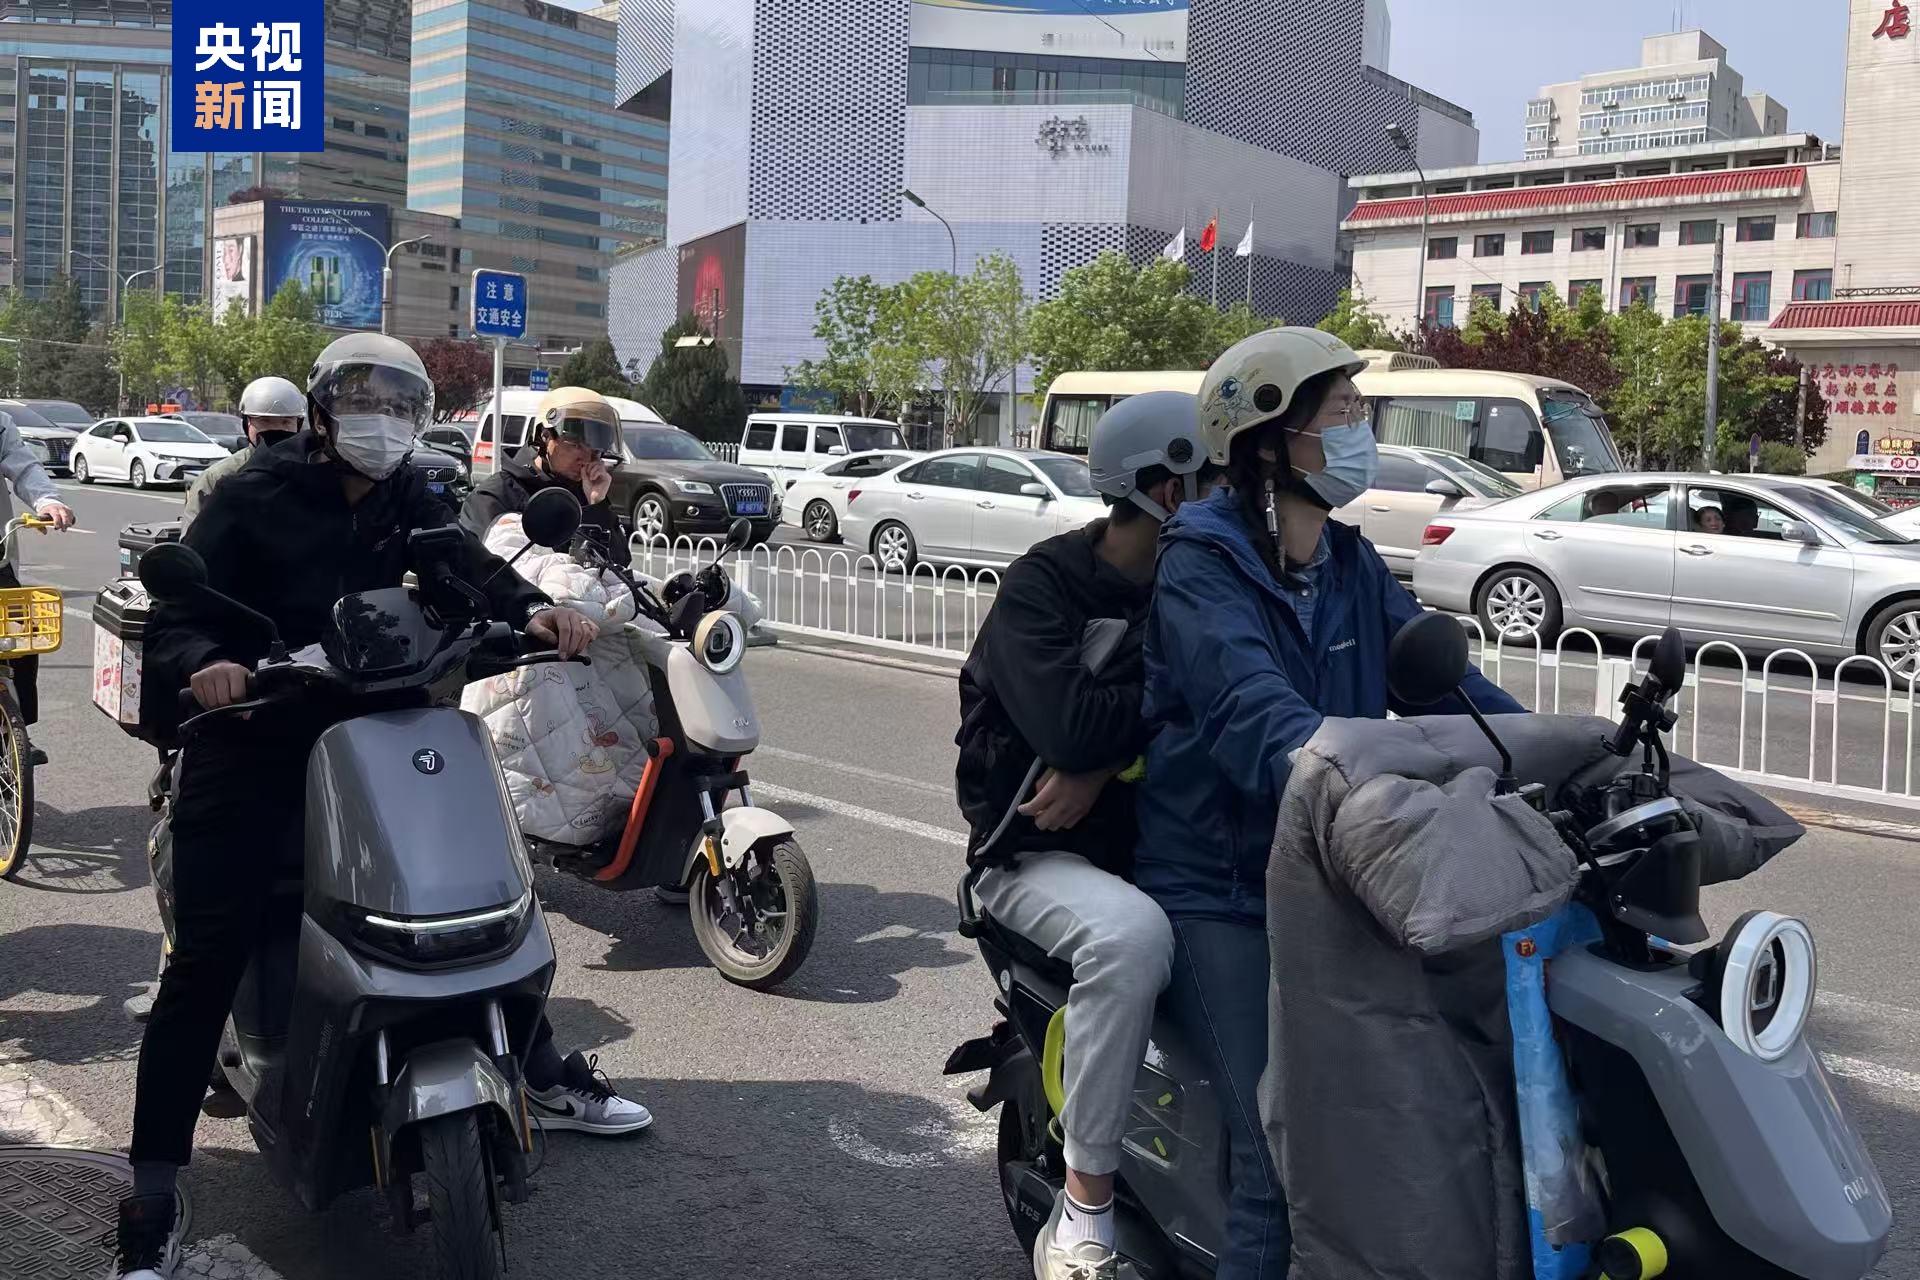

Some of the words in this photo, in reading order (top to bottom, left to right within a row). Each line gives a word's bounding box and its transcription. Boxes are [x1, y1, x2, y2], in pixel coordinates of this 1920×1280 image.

[1872, 0, 1911, 39] 店
[280, 205, 296, 214] THE
[343, 209, 371, 217] LOTION
[302, 215, 349, 225] COLLECTI
[486, 281, 515, 302] 注意
[477, 306, 523, 328] 交通安全
